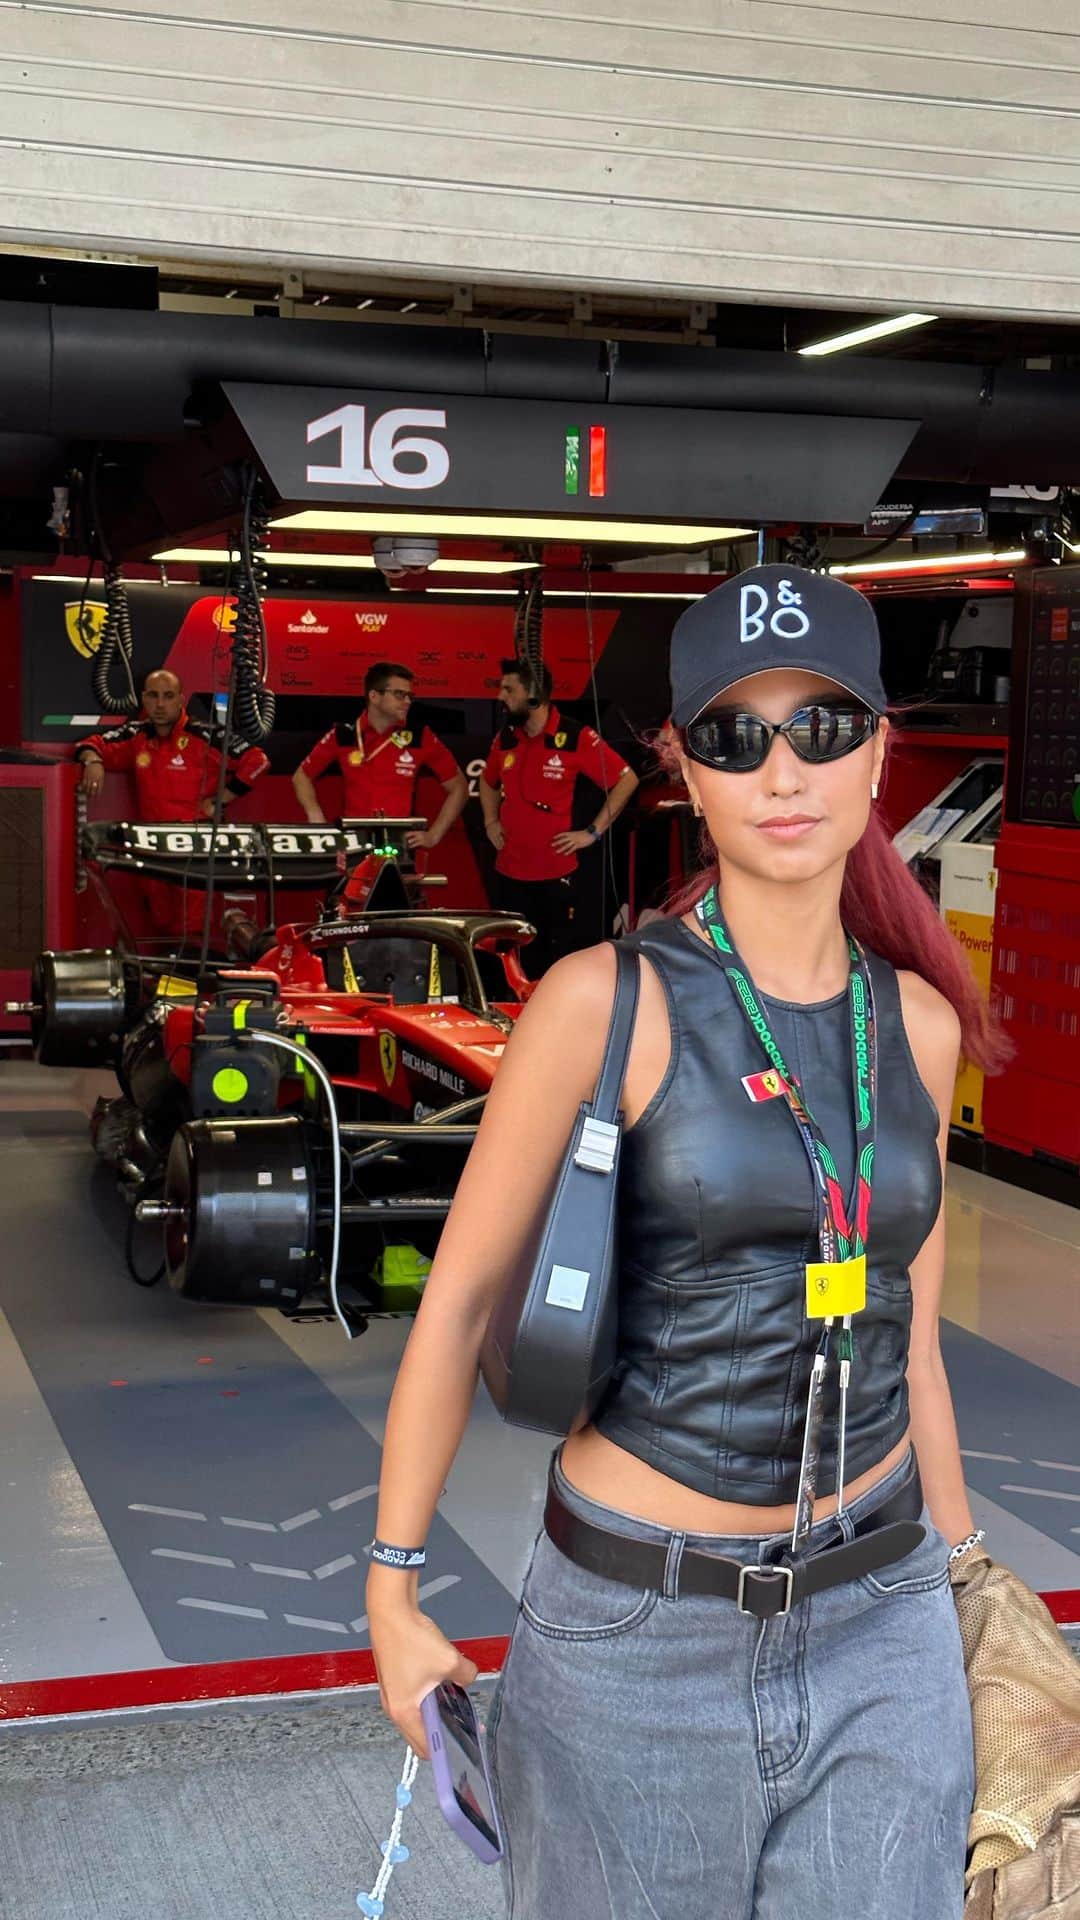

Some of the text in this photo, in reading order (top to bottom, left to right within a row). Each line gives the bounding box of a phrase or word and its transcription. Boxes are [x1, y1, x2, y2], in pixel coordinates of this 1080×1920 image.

[307, 404, 450, 489] 16
[288, 624, 329, 634] Santander
[355, 613, 388, 625] VGW
[132, 826, 362, 854] Ferrari
[322, 924, 370, 937] TECHNOLOGY
[960, 930, 993, 953] Power
[751, 1014, 790, 1079] PADDOCK
[853, 1014, 869, 1080] PADDOCK
[402, 1050, 465, 1095] RICHARD MILLE
